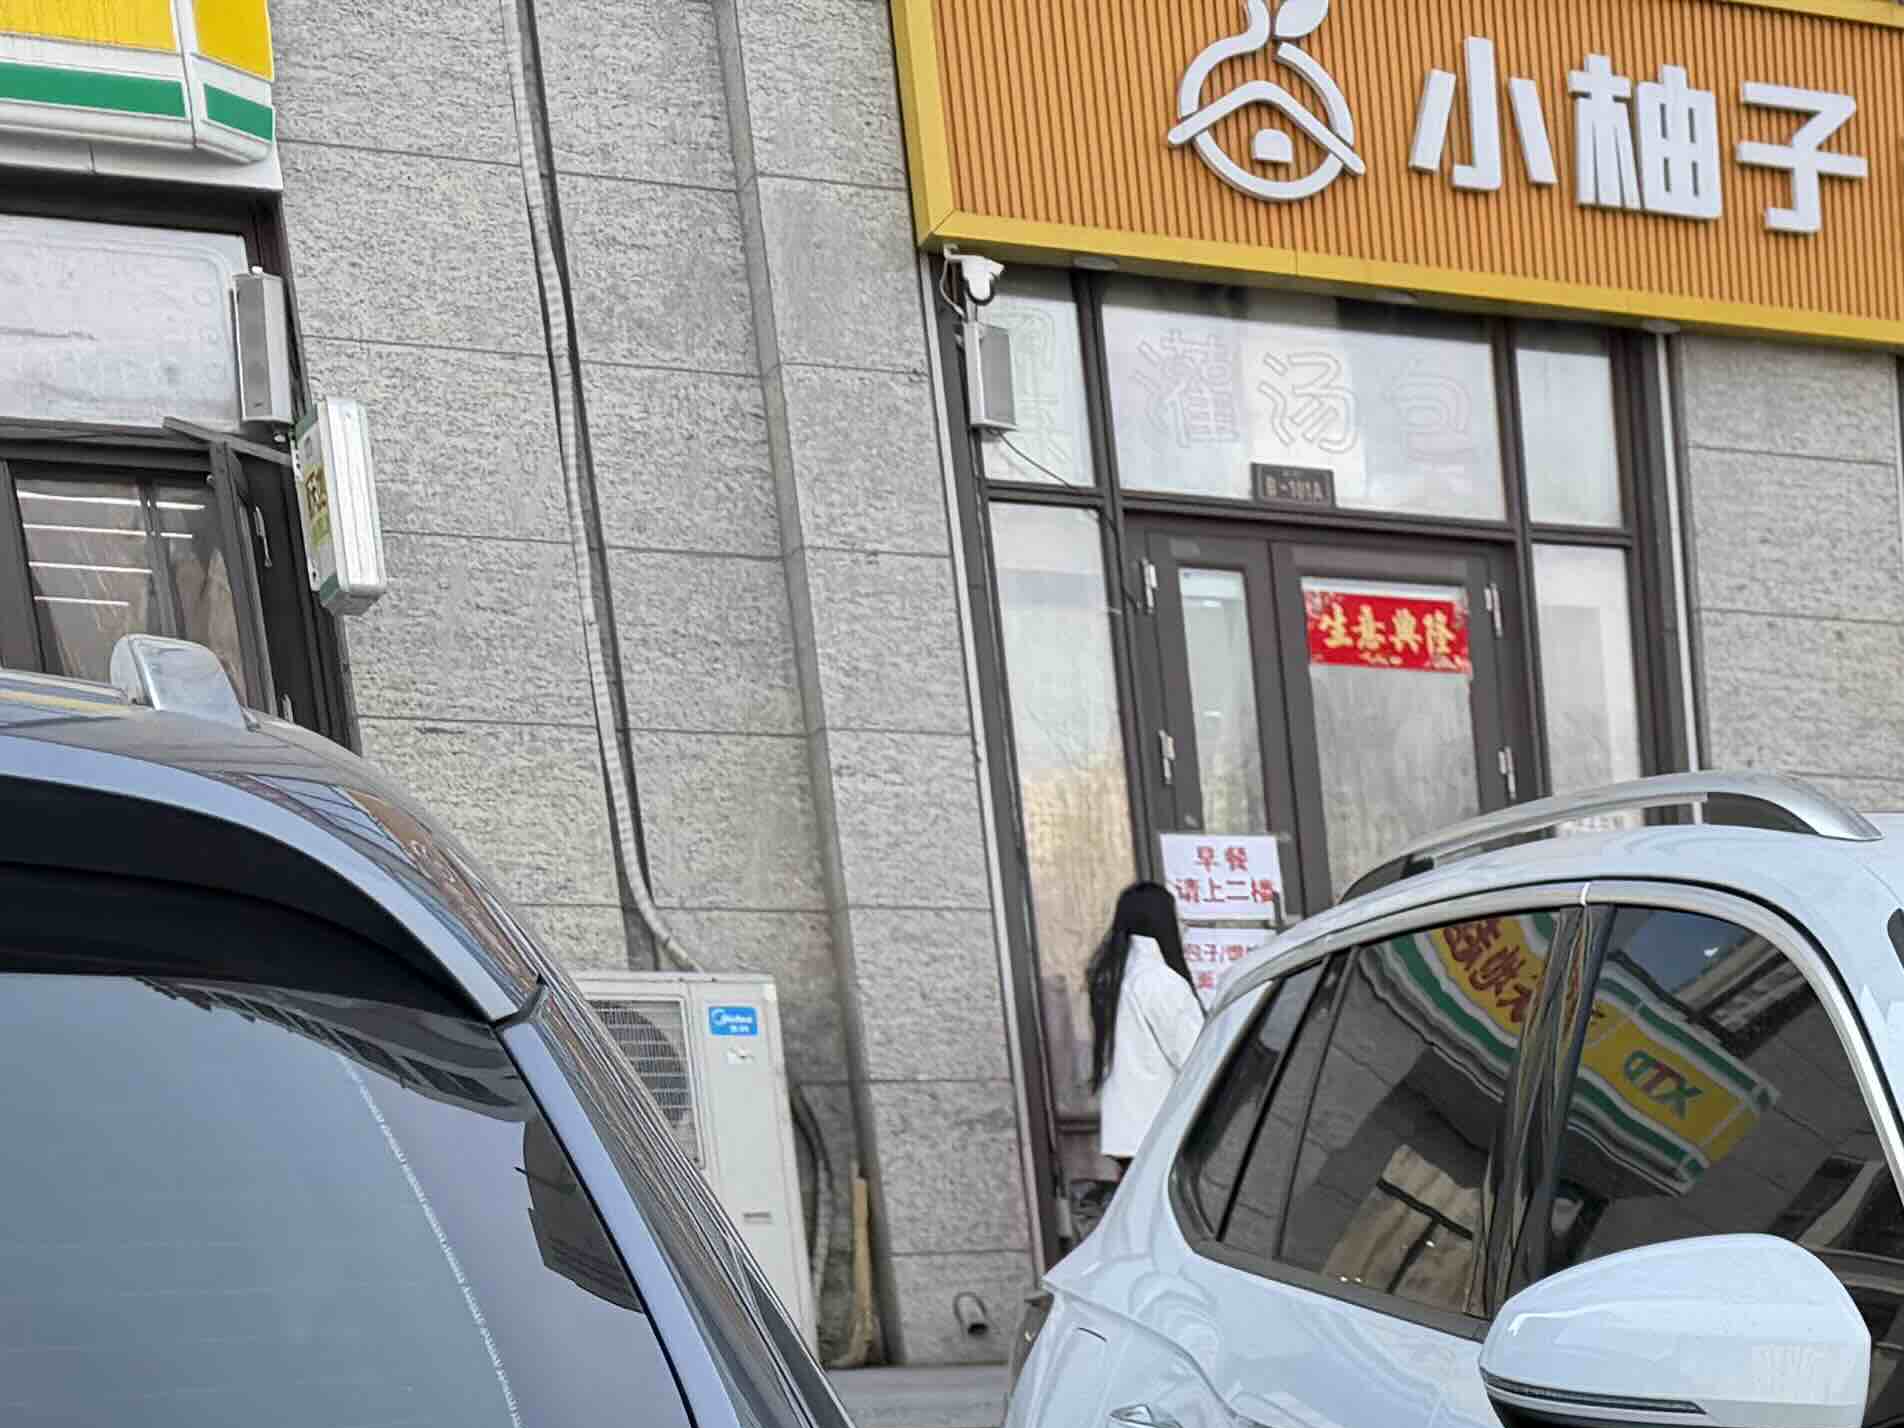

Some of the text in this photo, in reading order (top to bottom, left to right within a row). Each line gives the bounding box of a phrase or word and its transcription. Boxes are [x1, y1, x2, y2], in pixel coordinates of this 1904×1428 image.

[1409, 36, 1868, 235] 小柚子
[1195, 845, 1249, 873] 早餐
